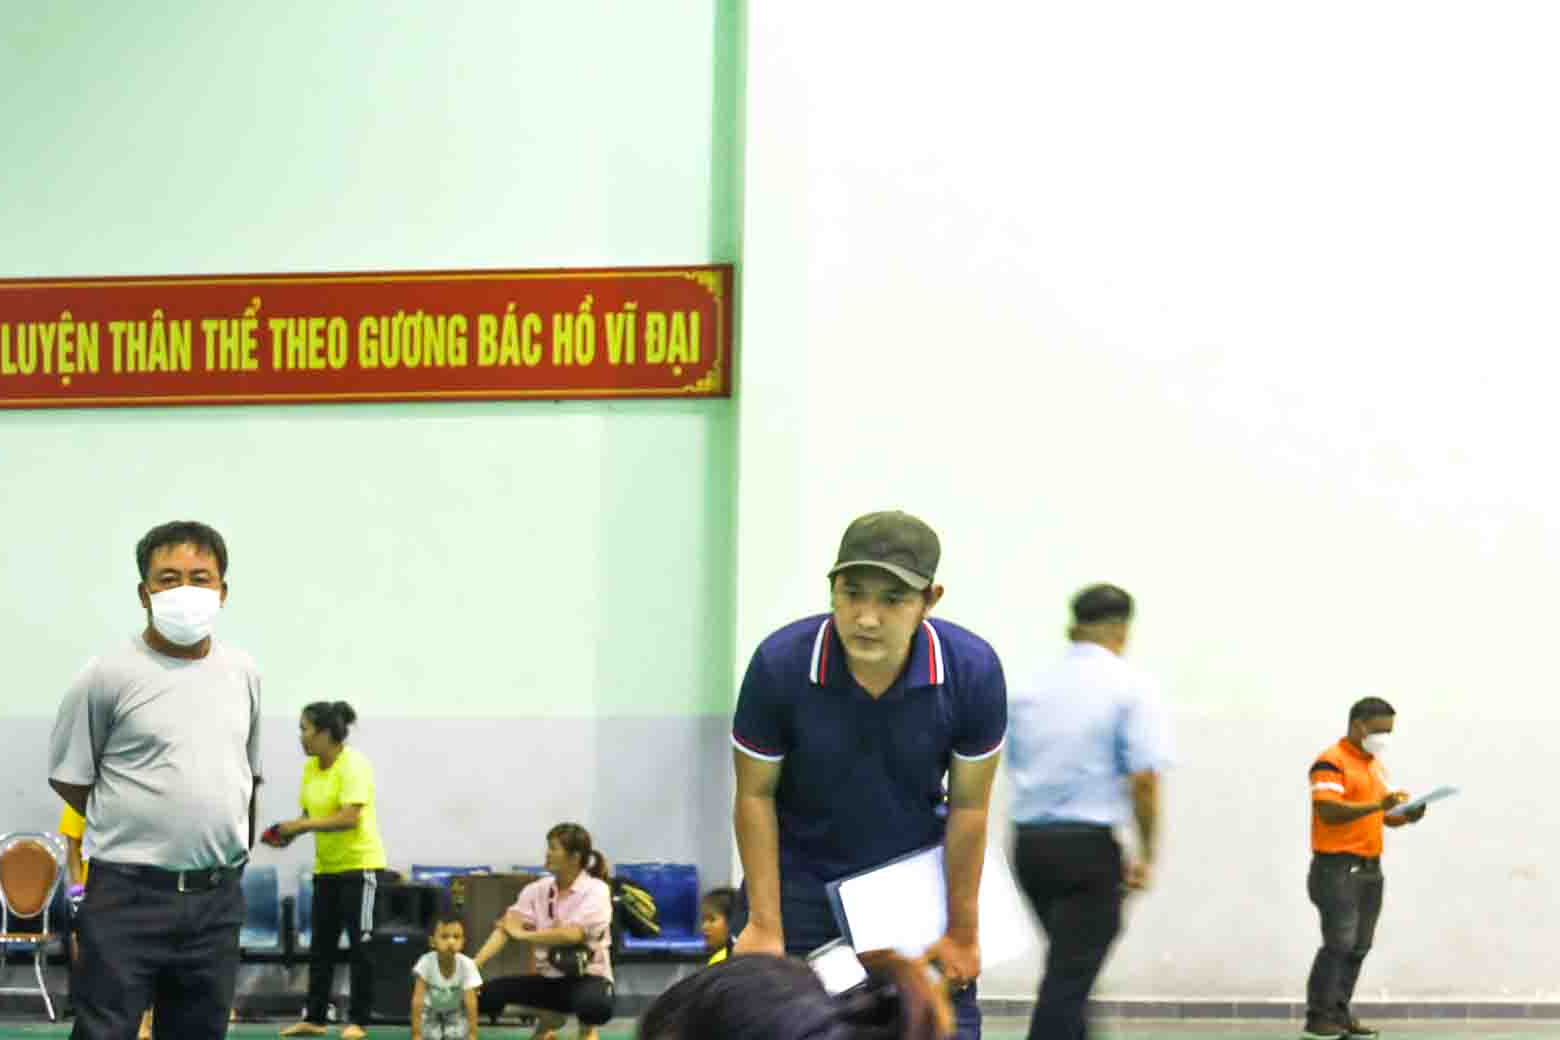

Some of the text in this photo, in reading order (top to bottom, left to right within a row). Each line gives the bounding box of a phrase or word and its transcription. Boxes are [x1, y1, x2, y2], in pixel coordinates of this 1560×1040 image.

[0, 310, 101, 386] LUYỆN
[109, 308, 192, 372] THÂN
[201, 296, 261, 370] THỂ
[268, 317, 348, 370] THEO
[358, 310, 468, 368] GƯƠNG
[477, 302, 543, 366] BÁC
[604, 301, 639, 366] VĨ
[645, 310, 701, 376] ĐẠI
